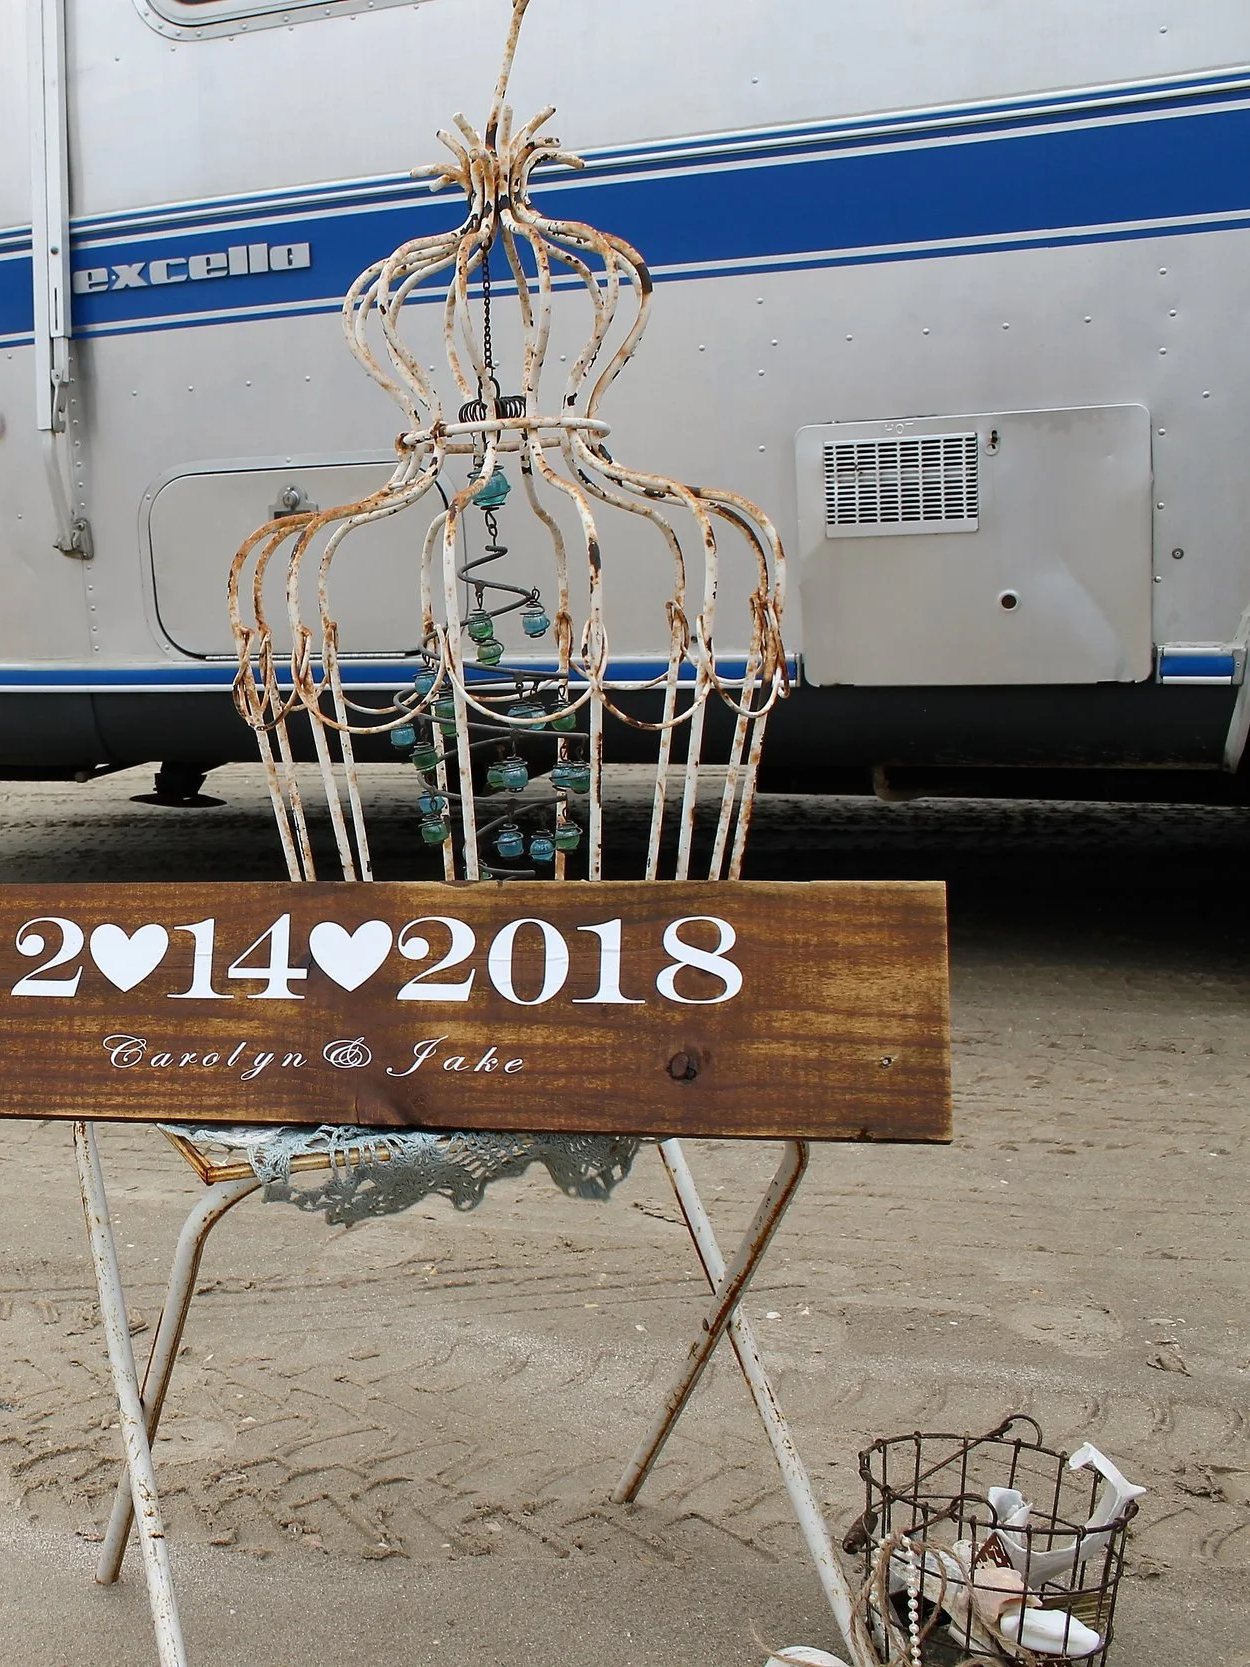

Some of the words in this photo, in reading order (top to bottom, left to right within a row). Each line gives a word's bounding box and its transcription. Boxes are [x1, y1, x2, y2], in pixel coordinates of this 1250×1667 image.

[72, 242, 311, 294] excella
[396, 915, 743, 1006] 2018
[102, 1034, 308, 1081] Carolyn
[322, 1036, 372, 1069] &
[386, 1034, 524, 1077] Jake
